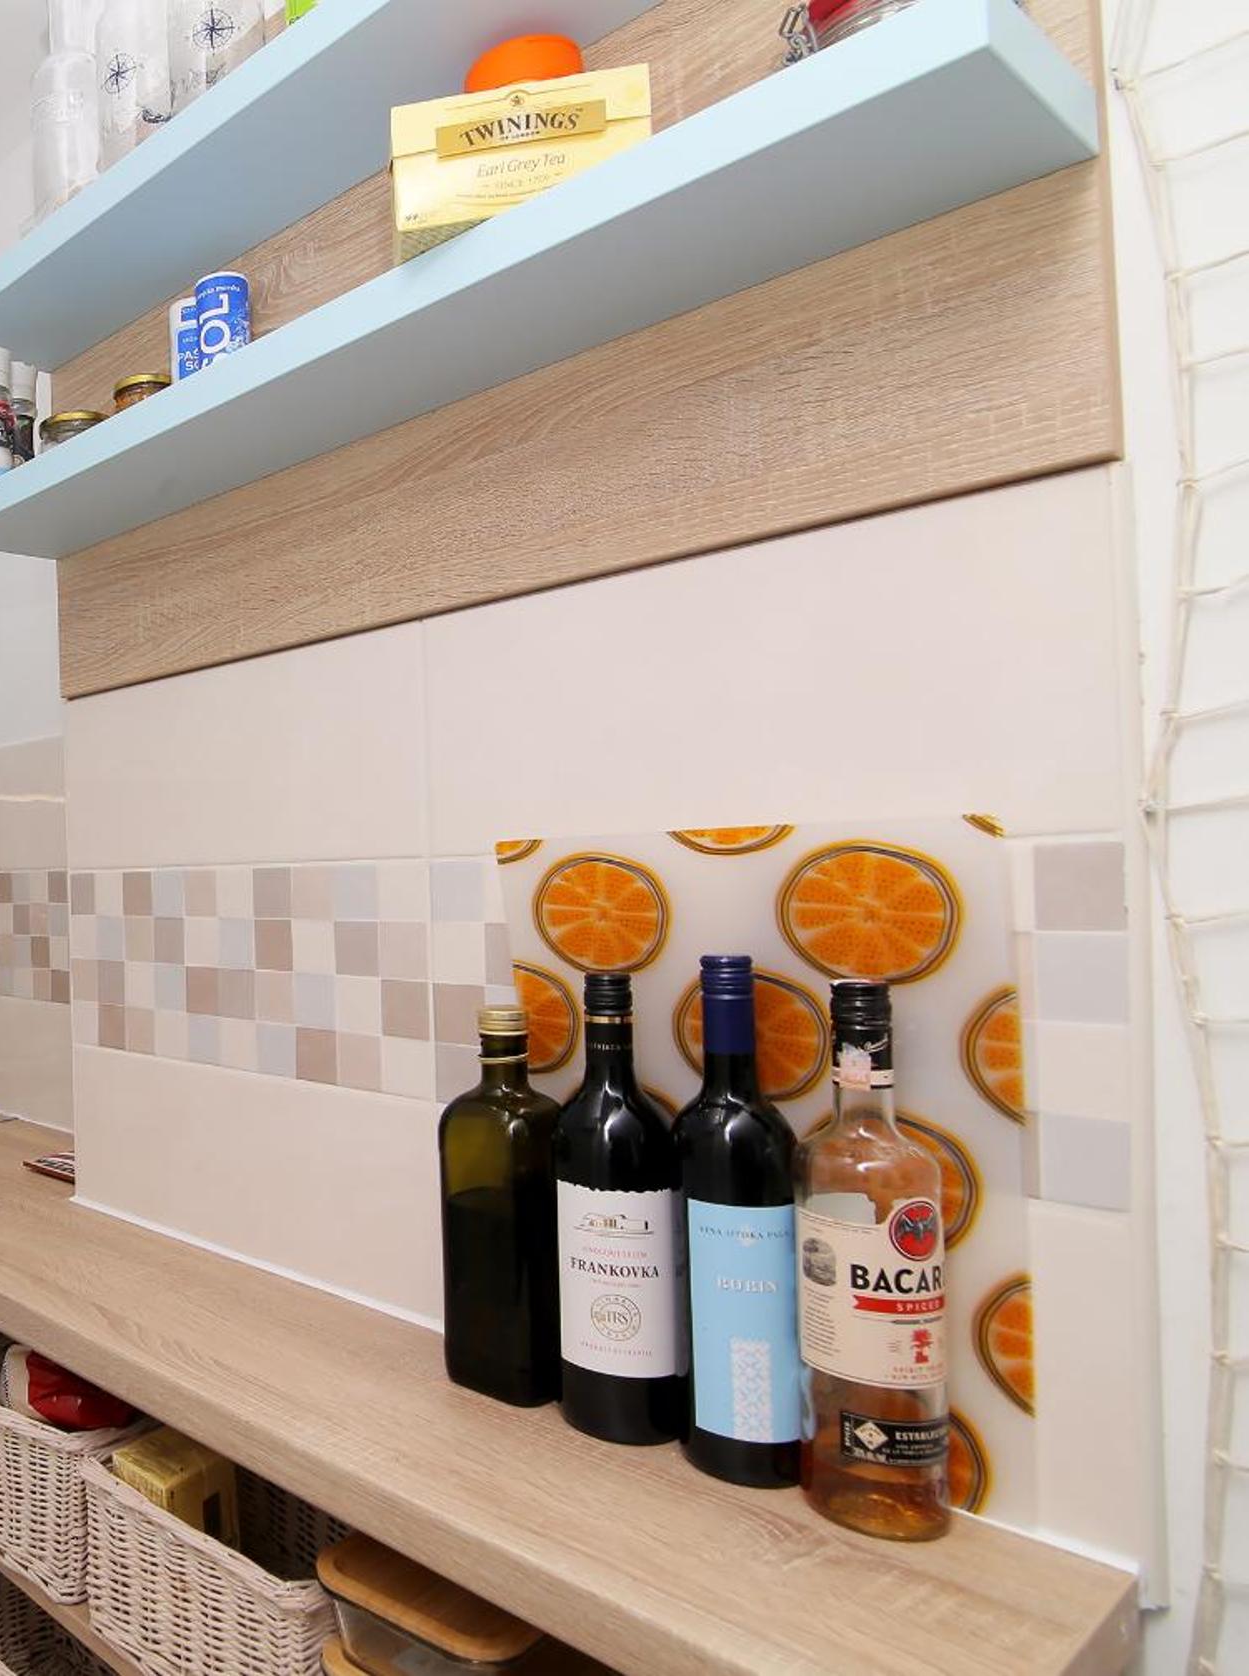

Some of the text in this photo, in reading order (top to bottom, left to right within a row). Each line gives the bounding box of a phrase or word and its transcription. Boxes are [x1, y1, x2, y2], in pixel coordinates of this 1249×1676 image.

[459, 112, 580, 146] TWININGS
[477, 152, 566, 178] Earl Grey Tea
[570, 1256, 659, 1278] FRANKOVKA
[851, 1264, 943, 1294] BACAR
